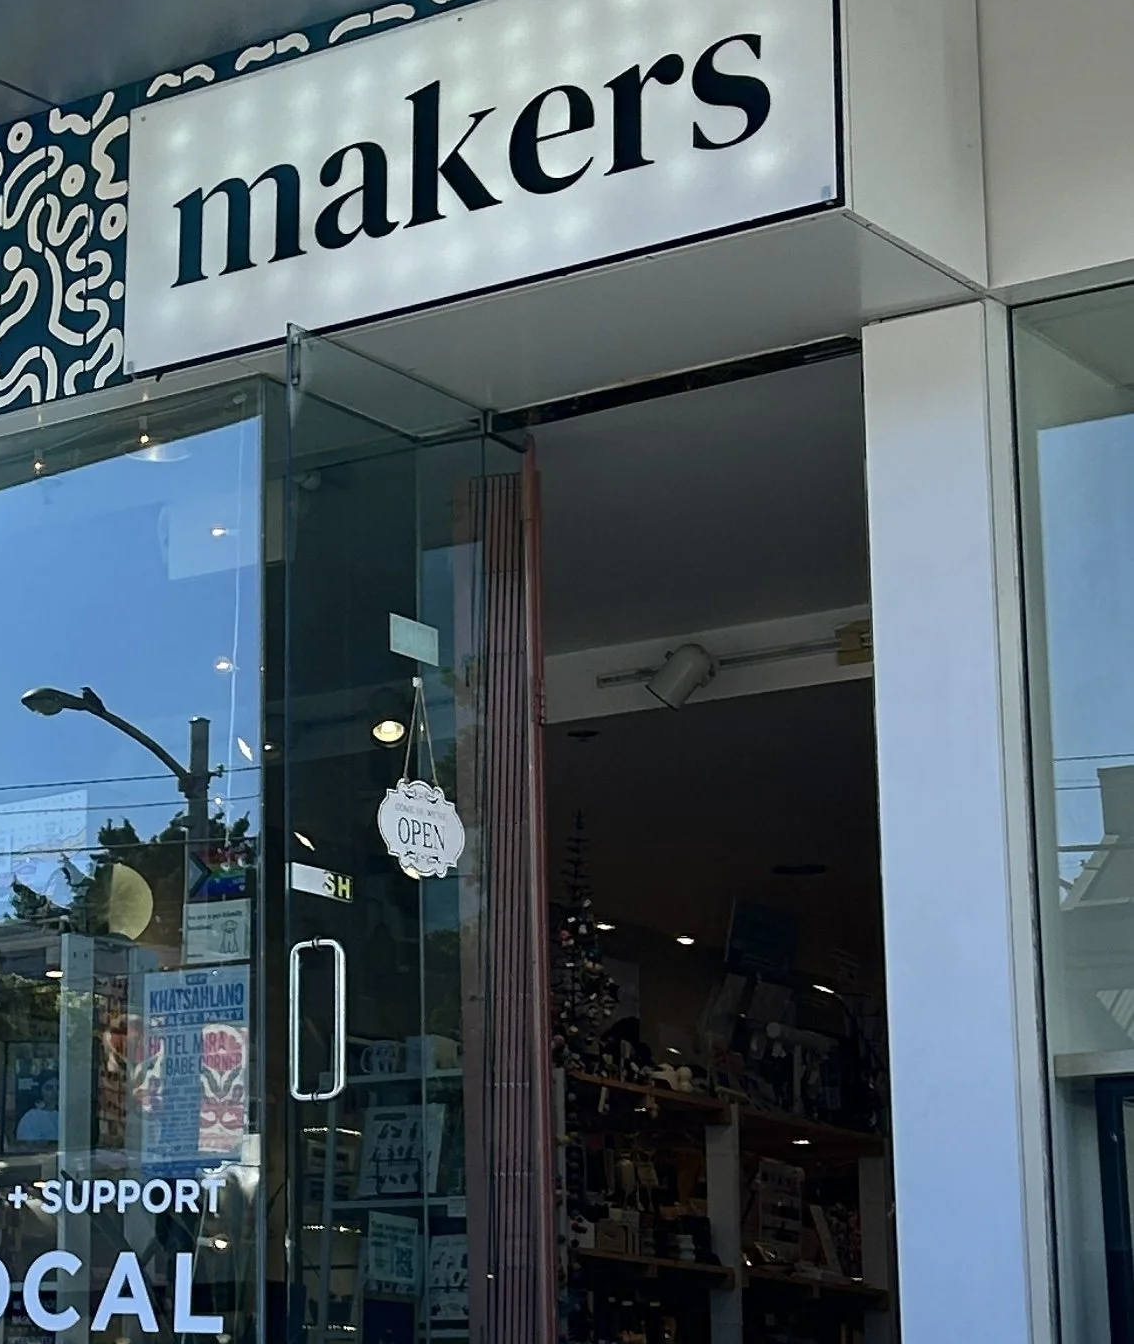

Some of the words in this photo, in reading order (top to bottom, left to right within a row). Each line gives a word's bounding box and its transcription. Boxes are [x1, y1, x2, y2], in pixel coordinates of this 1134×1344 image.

[169, 33, 772, 289] makers
[398, 816, 446, 851] OPEN
[166, 1056, 196, 1076] BABE
[8, 1185, 28, 1209] +
[40, 1178, 227, 1215] SUPPORT
